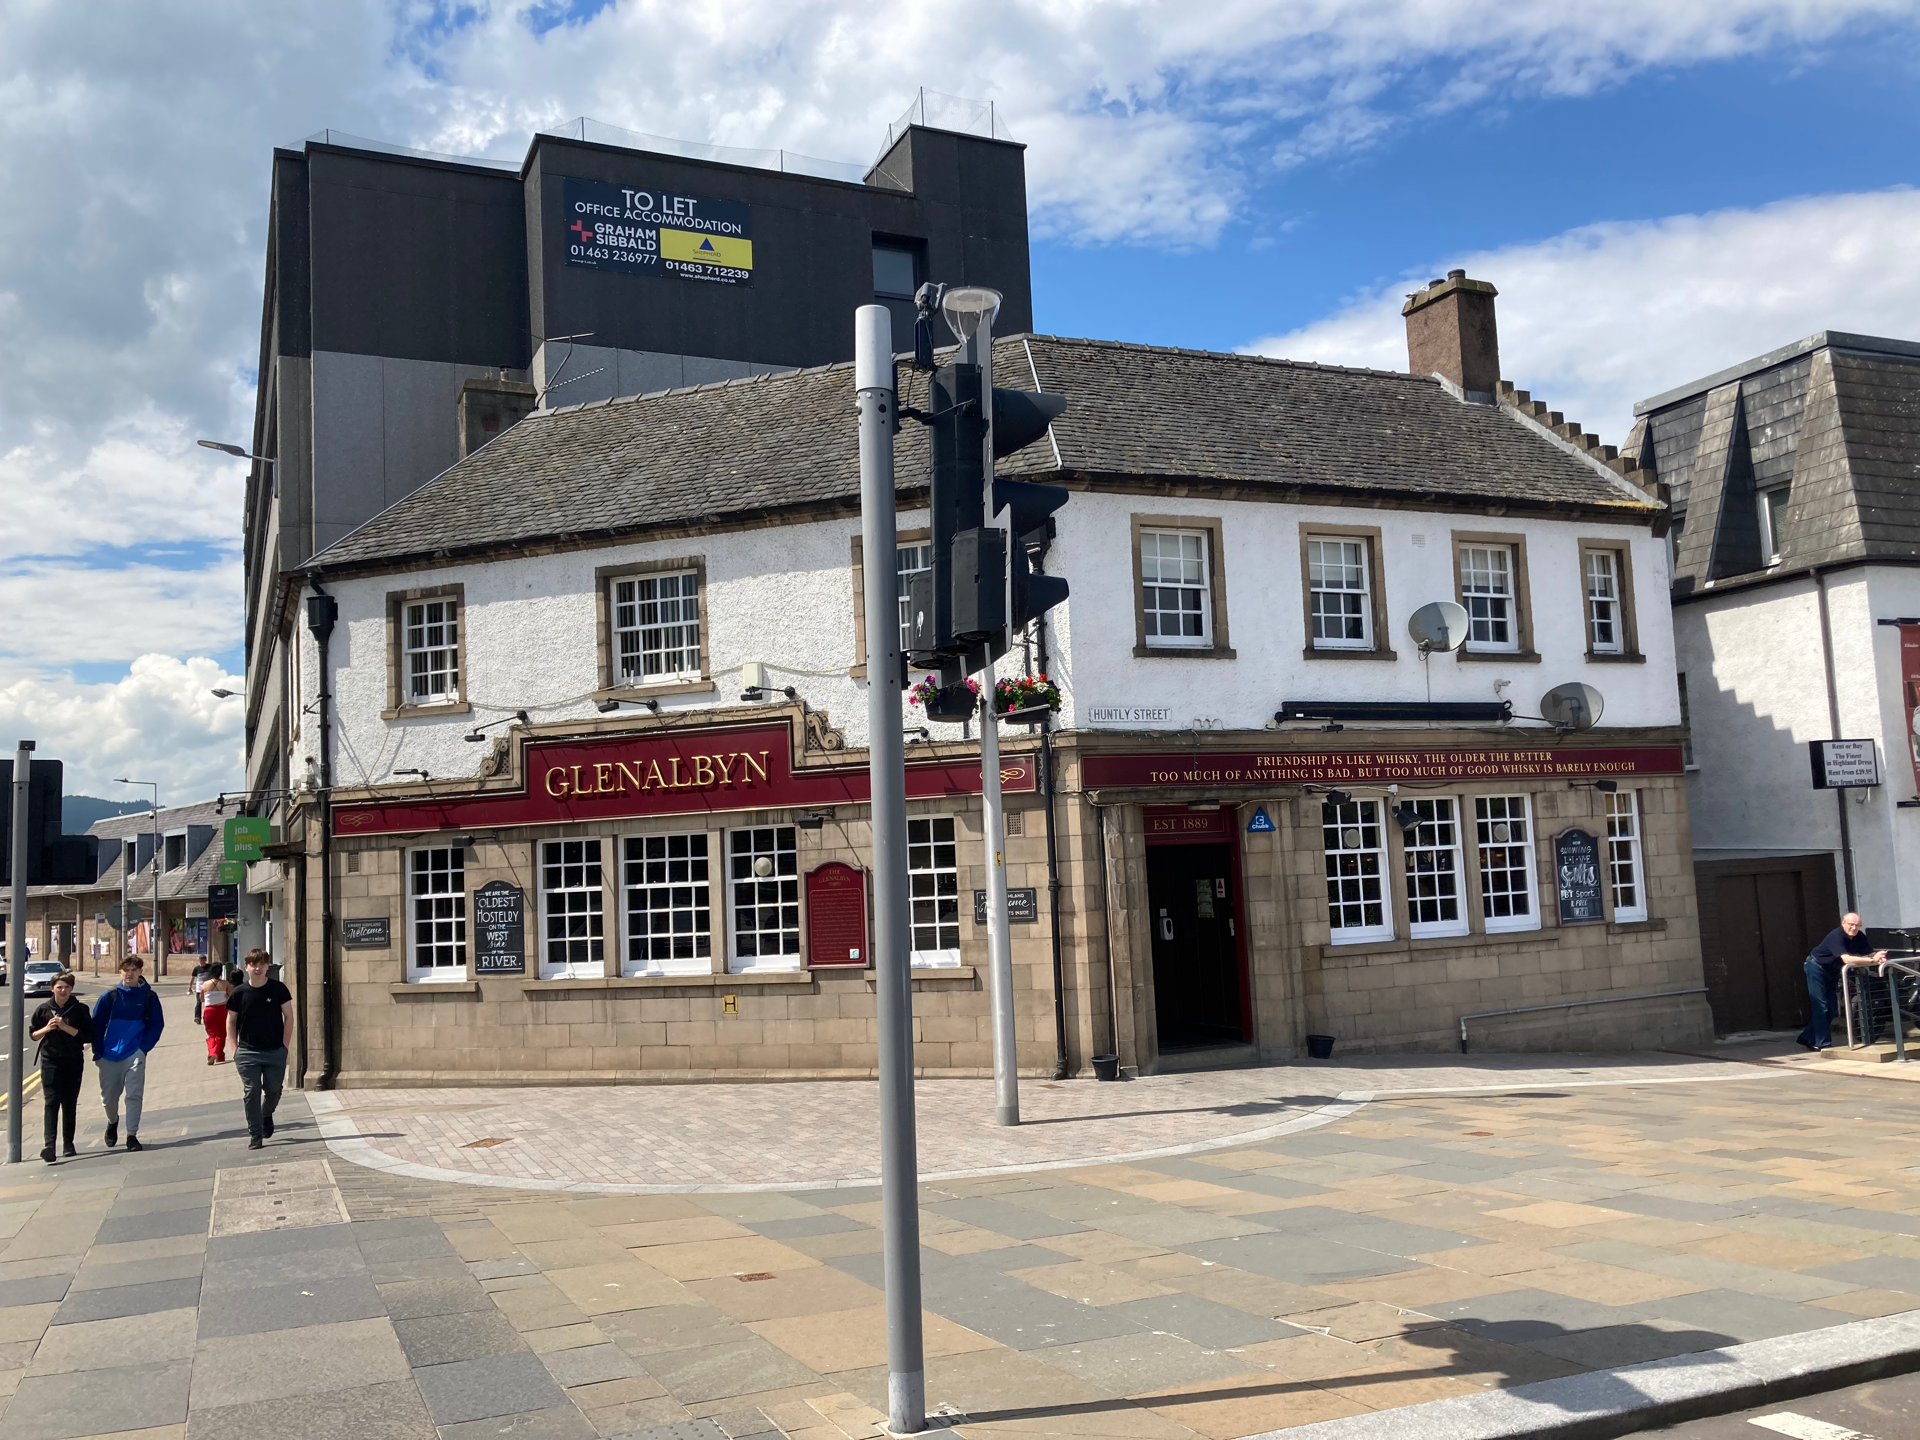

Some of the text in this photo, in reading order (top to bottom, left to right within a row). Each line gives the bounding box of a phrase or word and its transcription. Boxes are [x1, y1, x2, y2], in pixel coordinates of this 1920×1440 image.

[621, 189, 697, 217] TO LET
[575, 202, 742, 235] OFFICE ACCOMMODATION
[594, 222, 656, 240] GRAHAM
[596, 234, 656, 251] SIBBALD
[570, 244, 657, 265] 01463 236977
[692, 249, 721, 257] SHEPHERD
[665, 260, 749, 279] 01463 712239
[680, 272, 736, 284] www.shepherd.co.uk
[1093, 708, 1168, 720] HUNTLY STREET
[1257, 752, 1552, 766] FRIENDSHIP IS LIKE WHISKY, THE OLDER THE BETTER
[1832, 759, 1856, 767] Highland
[545, 751, 769, 796] GLENALBYN
[1150, 762, 1635, 782] TOO MUCH OF ANYTHING IS BAD, BUT TOO MUCH OF GOOD WHISKY IS BARELY ENOUGH
[234, 825, 248, 835] job
[1153, 818, 1208, 830] EST 1889
[233, 834, 262, 842] centre
[234, 843, 252, 852] plus
[818, 875, 851, 883] GLENALBYN
[1564, 889, 1595, 899] BT Sport
[478, 896, 516, 908] OLDEST
[347, 926, 383, 939] Welcome
[486, 931, 509, 941] WEST
[481, 955, 517, 968] RIVER
